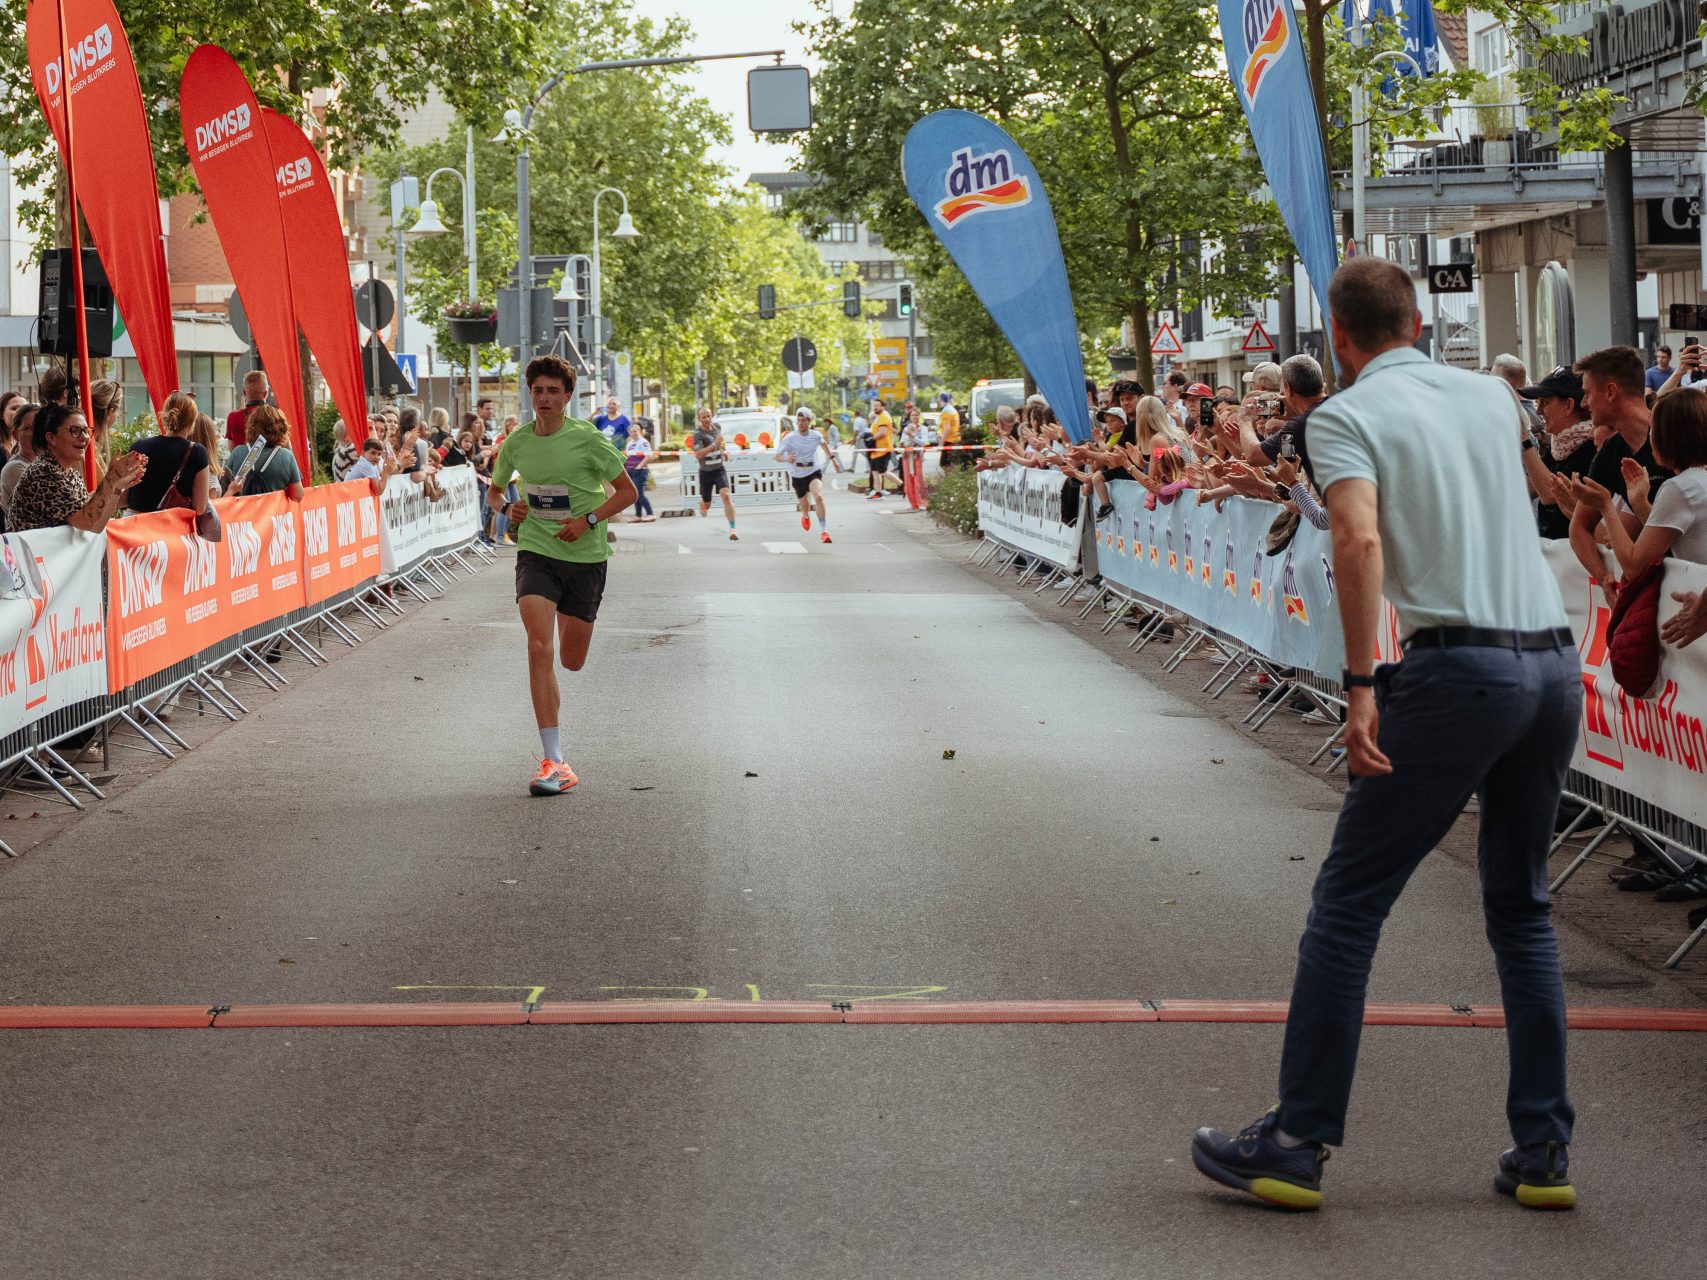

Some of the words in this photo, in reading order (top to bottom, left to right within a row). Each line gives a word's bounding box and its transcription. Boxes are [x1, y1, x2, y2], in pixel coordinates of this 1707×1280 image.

[195, 110, 238, 151] DKMS
[949, 152, 1010, 197] dm
[1661, 196, 1700, 230] C&
[1434, 269, 1467, 289] C&A
[49, 603, 103, 676] Kaufland
[1618, 679, 1707, 774] Kauflan
